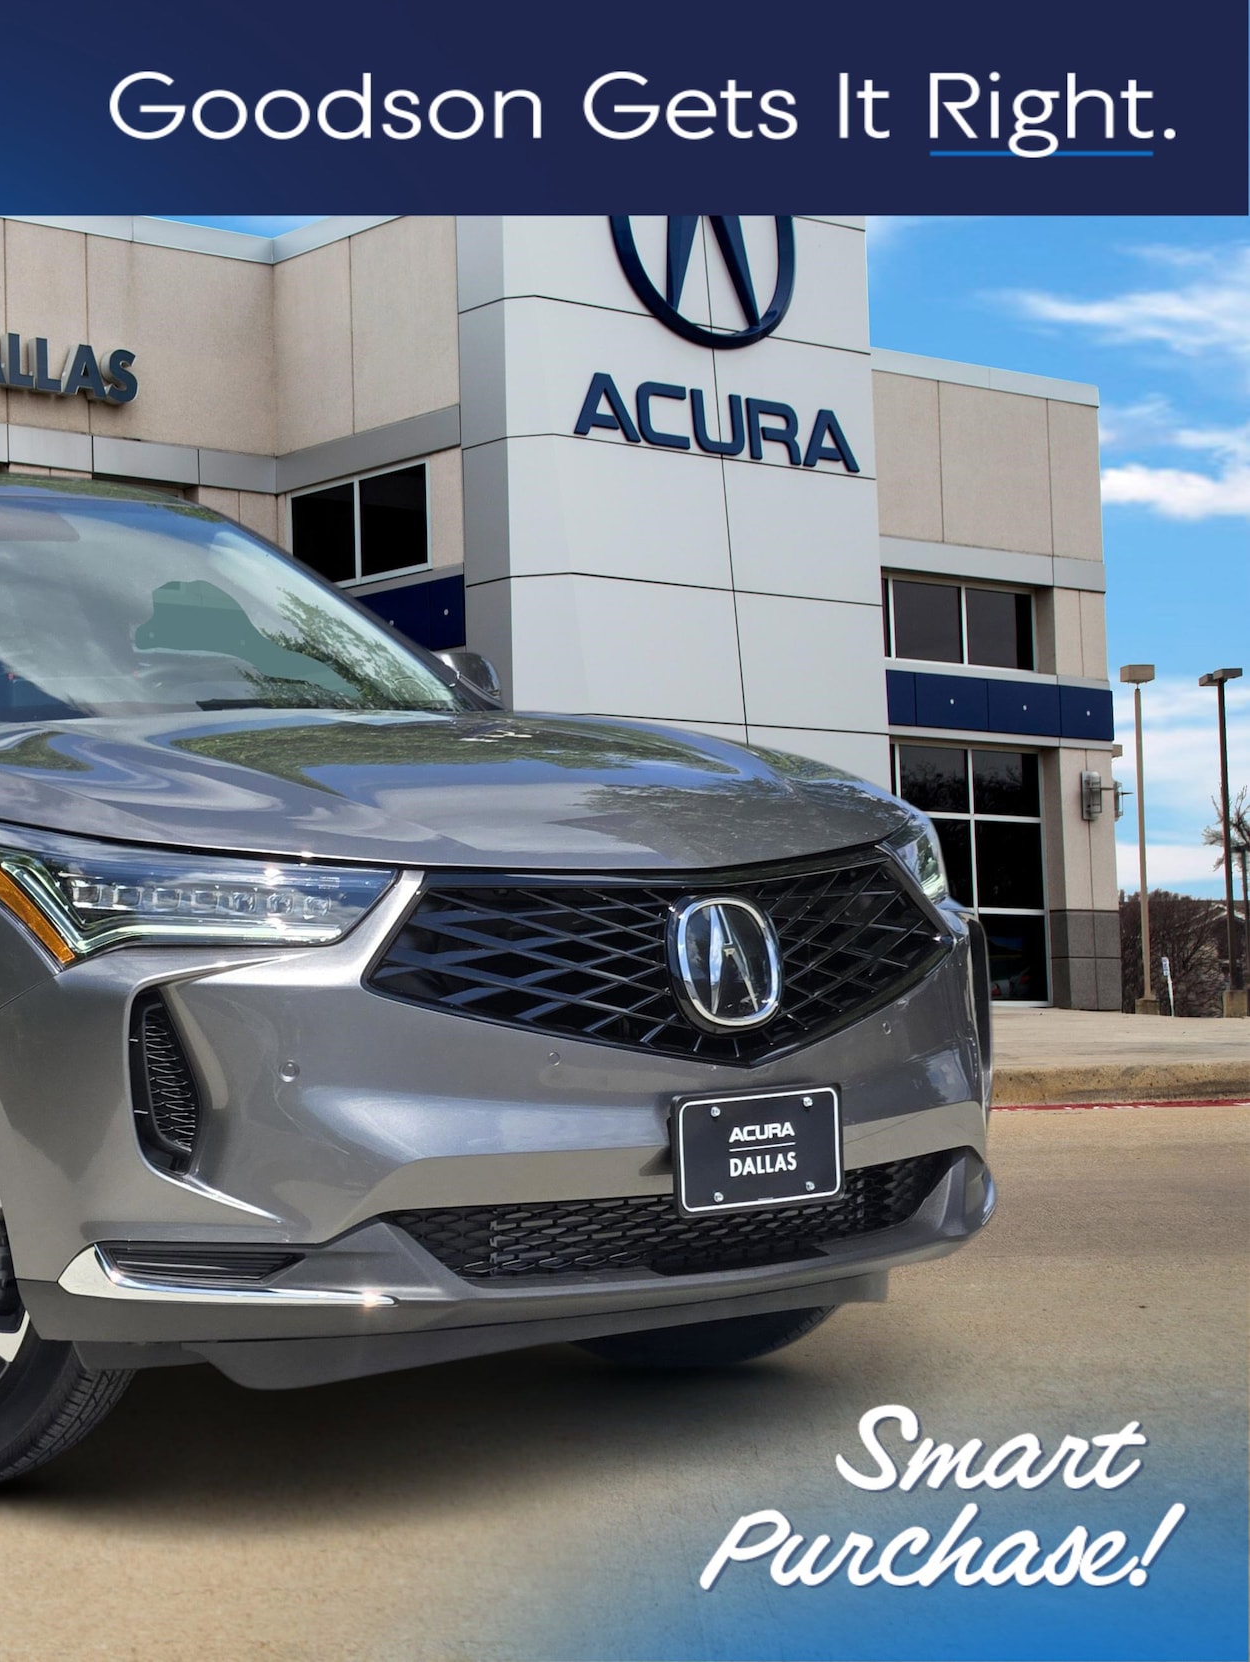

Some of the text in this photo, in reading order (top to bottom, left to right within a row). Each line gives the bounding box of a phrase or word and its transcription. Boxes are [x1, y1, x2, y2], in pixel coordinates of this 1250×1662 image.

[573, 372, 860, 473] ACURA
[728, 1121, 796, 1144] ACURA
[728, 1151, 798, 1178] DALLAS
